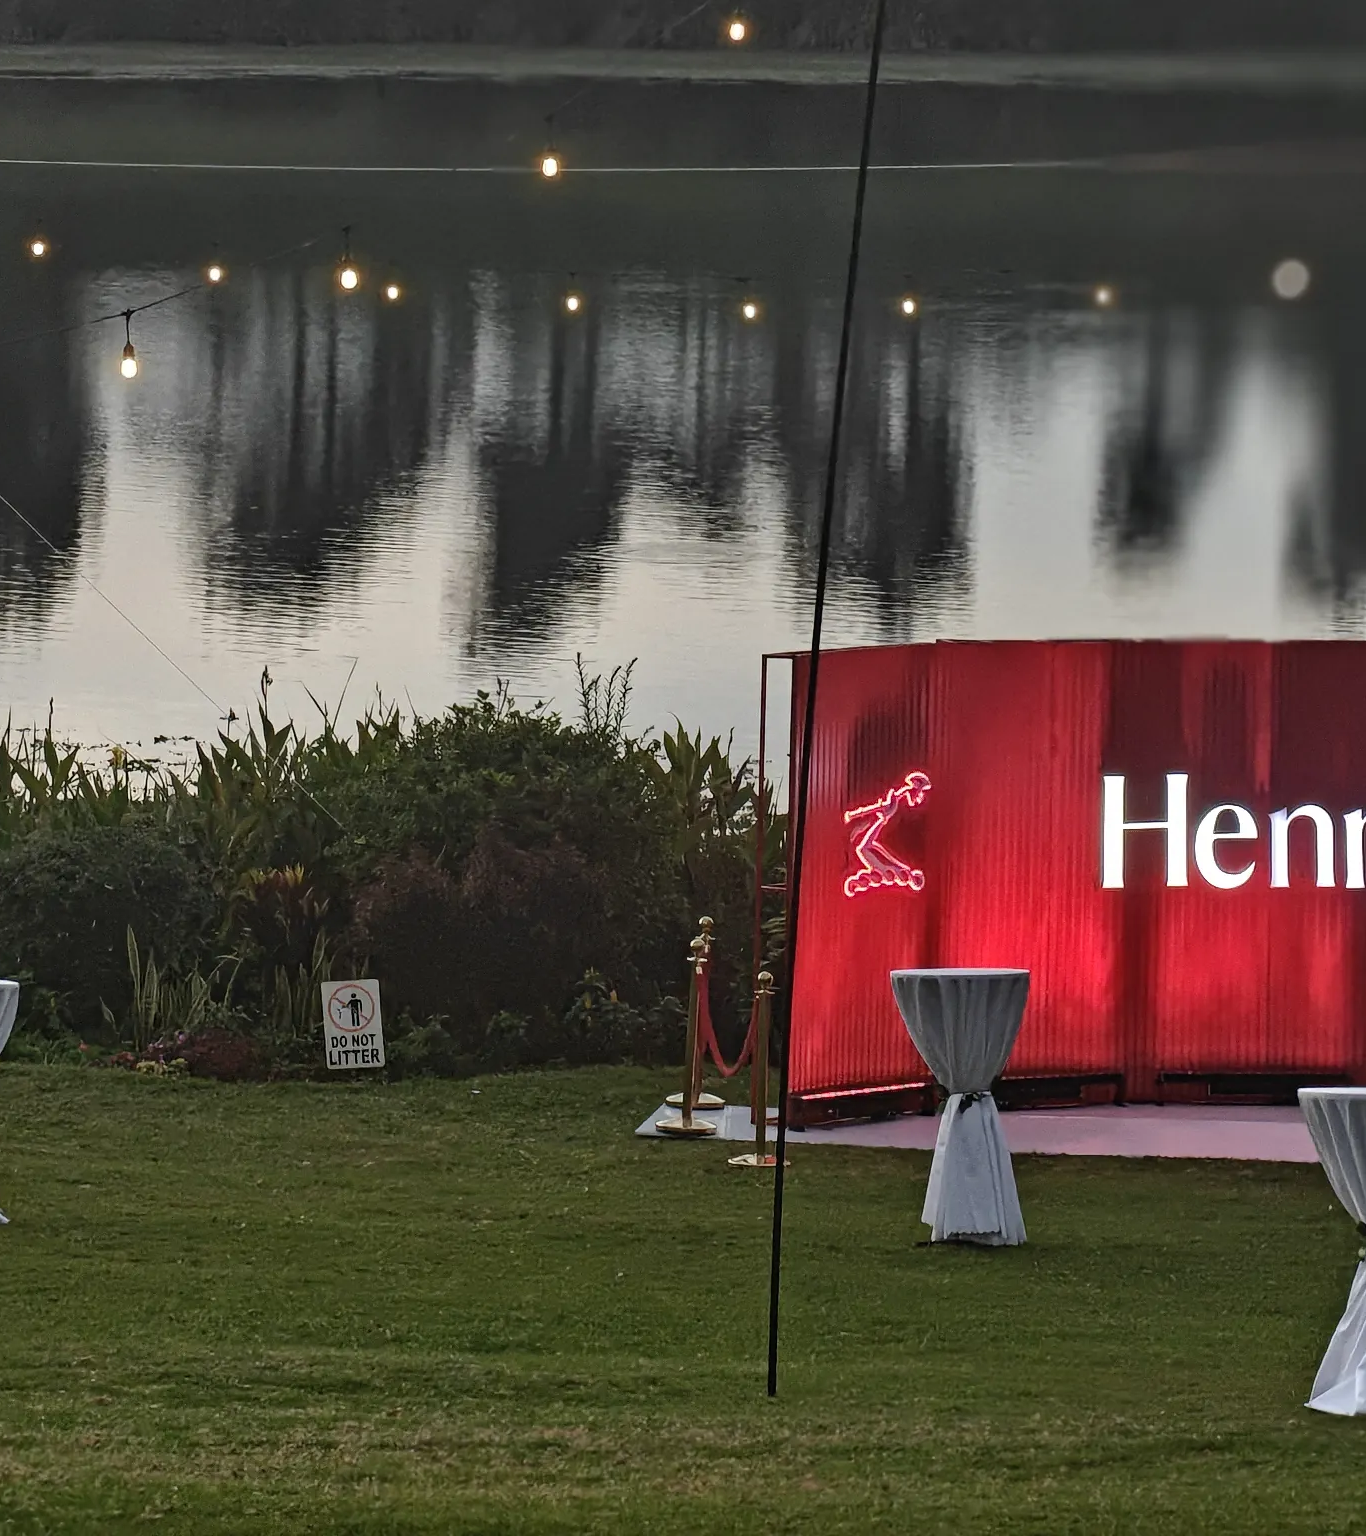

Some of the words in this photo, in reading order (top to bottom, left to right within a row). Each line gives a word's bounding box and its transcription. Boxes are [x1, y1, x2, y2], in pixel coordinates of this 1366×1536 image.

[331, 1036, 348, 1049] DO
[352, 1033, 377, 1047] NOT
[329, 1048, 381, 1066] LITTER
